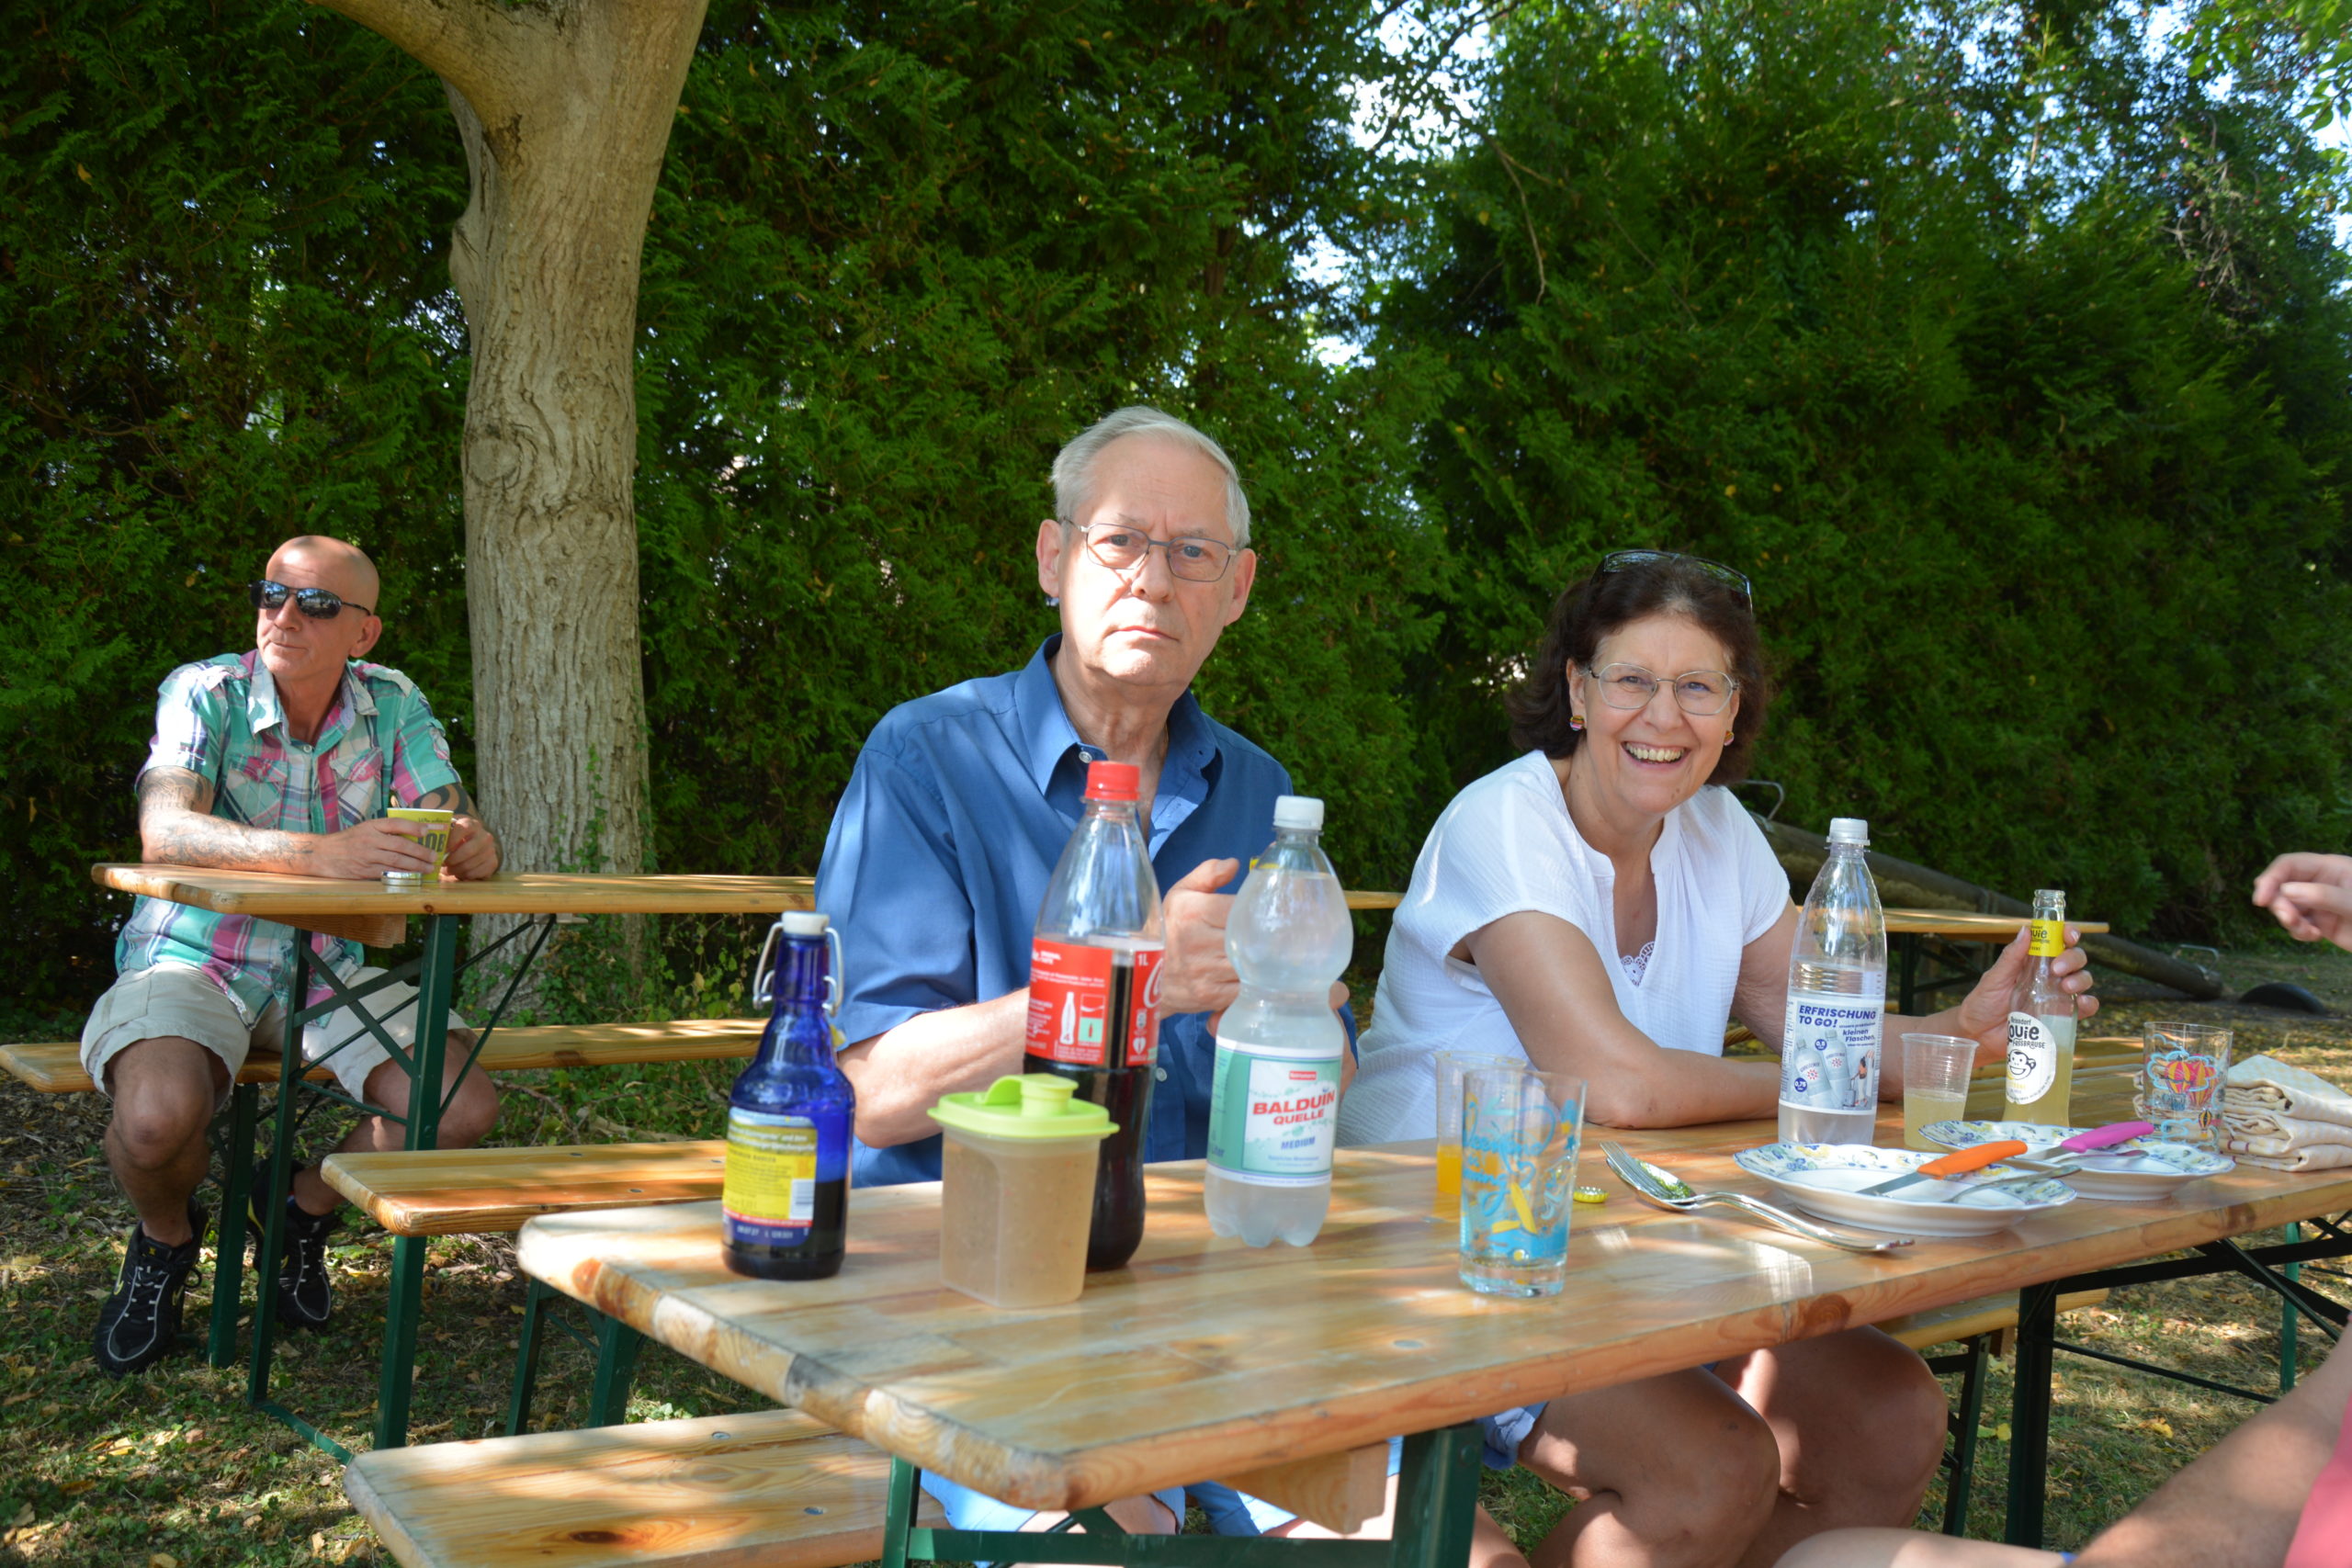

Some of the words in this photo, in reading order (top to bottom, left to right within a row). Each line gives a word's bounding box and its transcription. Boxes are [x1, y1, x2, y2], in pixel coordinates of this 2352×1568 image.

[1137, 953, 1148, 966] 1L
[1799, 1005, 1876, 1020] ERFRISCHUNG
[1799, 1015, 1812, 1025] TO
[1815, 1018, 1838, 1028] GO!
[1252, 1089, 1336, 1115] BALDUIN
[1273, 1109, 1324, 1125] QUELLE
[1281, 1136, 1316, 1150] MEDIUM
